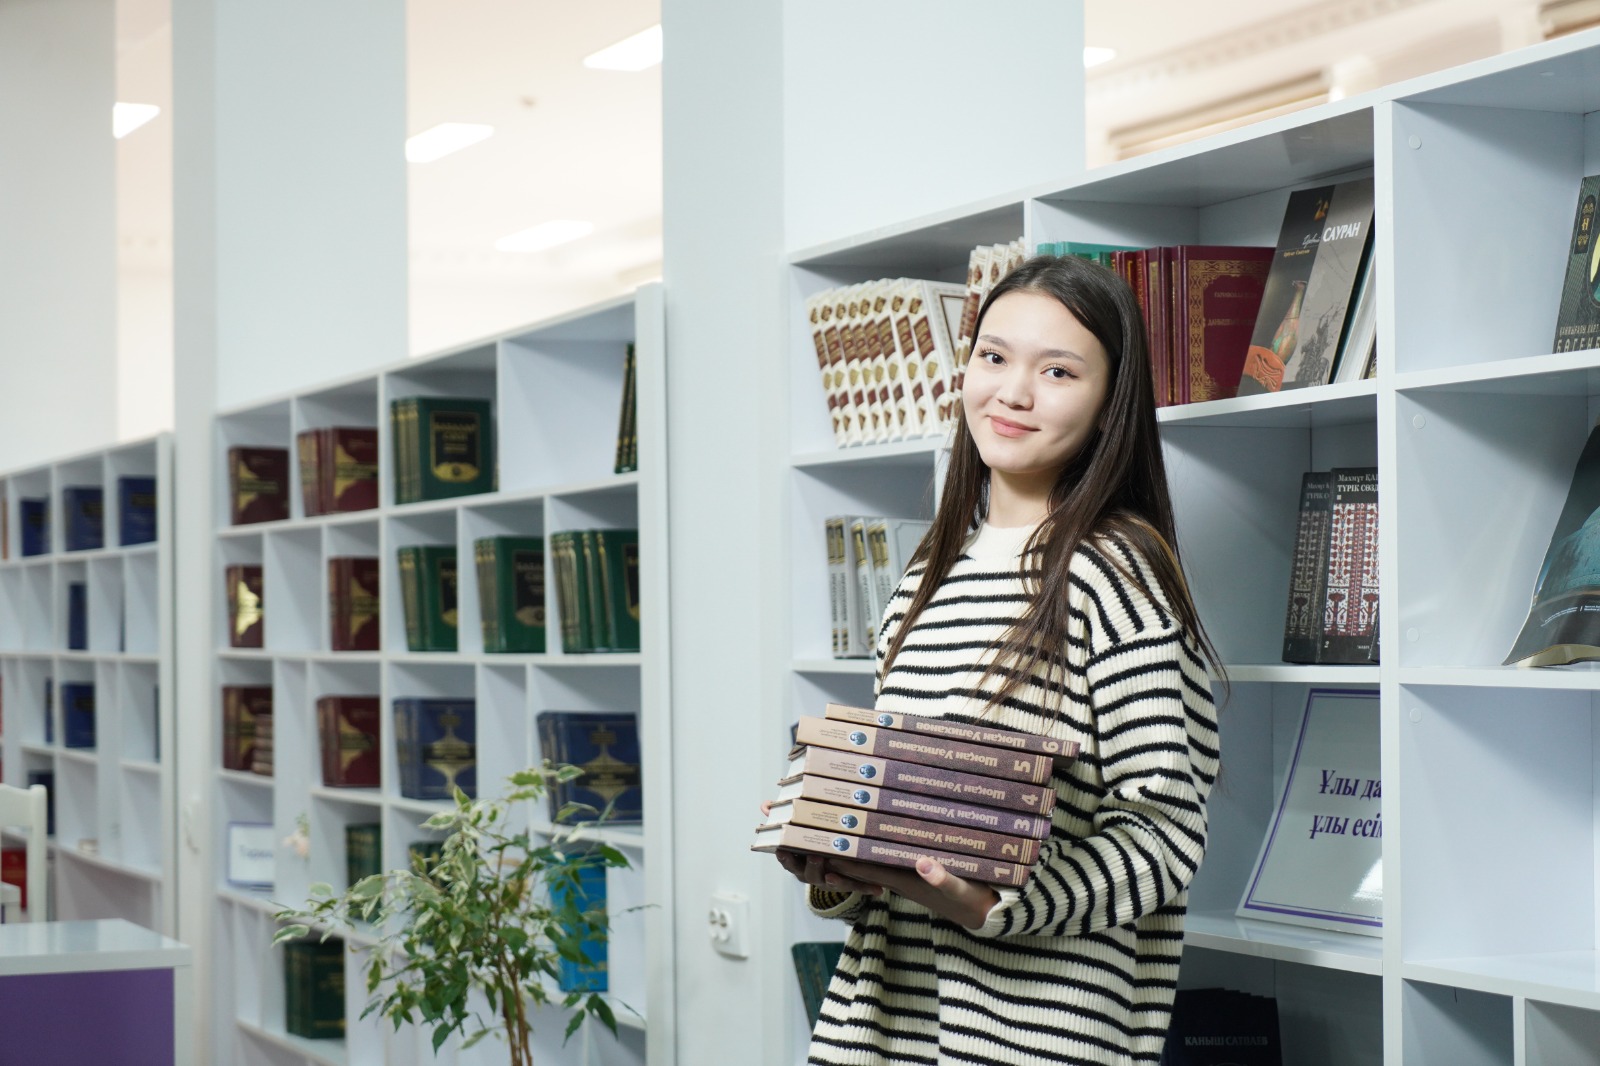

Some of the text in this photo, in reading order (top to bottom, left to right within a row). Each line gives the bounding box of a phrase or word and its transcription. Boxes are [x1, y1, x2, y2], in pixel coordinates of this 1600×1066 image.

[1322, 222, 1362, 242] САУРАН
[1337, 484, 1360, 492] ТҮРІК
[915, 722, 1026, 748] Шоқан Уәлиханов
[888, 740, 998, 767] Шоқан Уәлиханов
[1042, 741, 1059, 753] 6
[1013, 760, 1031, 773] 5
[898, 773, 1005, 800] Шоқан Уәлиханов
[1318, 769, 1360, 796] Ұлы
[1021, 794, 1038, 806] 4
[891, 799, 998, 826] Шоқан Уәлиханов
[1013, 818, 1031, 832] 3
[1309, 814, 1349, 840] ұлы
[879, 823, 986, 851] Шоқан Уәлиханов
[1001, 843, 1018, 856] 2
[937, 857, 979, 873] Шоқан
[994, 867, 1010, 878] 1
[1184, 1035, 1224, 1046] КАНЫШ
